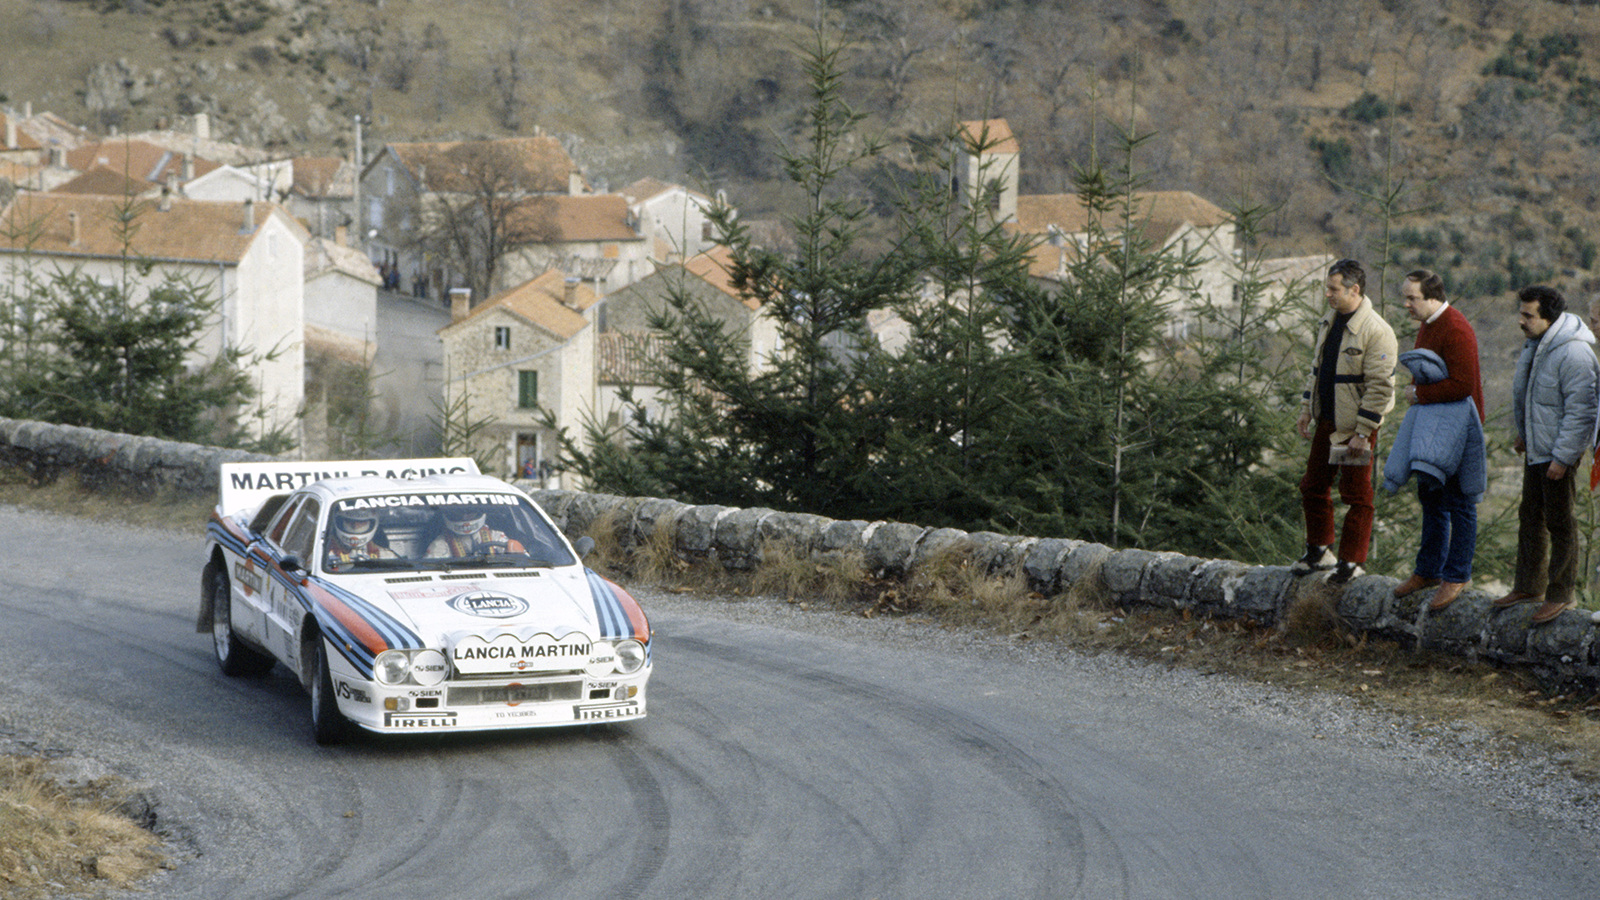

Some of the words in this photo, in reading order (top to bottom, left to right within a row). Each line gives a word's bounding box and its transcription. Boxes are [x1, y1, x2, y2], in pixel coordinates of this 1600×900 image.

[361, 466, 466, 480] ACI
[338, 495, 425, 512] LANCIA
[425, 494, 520, 506] MARTINI
[472, 599, 511, 610] LANCIA
[454, 646, 516, 660] LANCIA
[521, 643, 590, 658] MARTINI
[595, 655, 615, 664] SIEM
[425, 664, 445, 672] SIEM
[334, 679, 351, 700] VS
[572, 700, 639, 720] PIRELLI
[384, 711, 458, 728] PIRELLI
